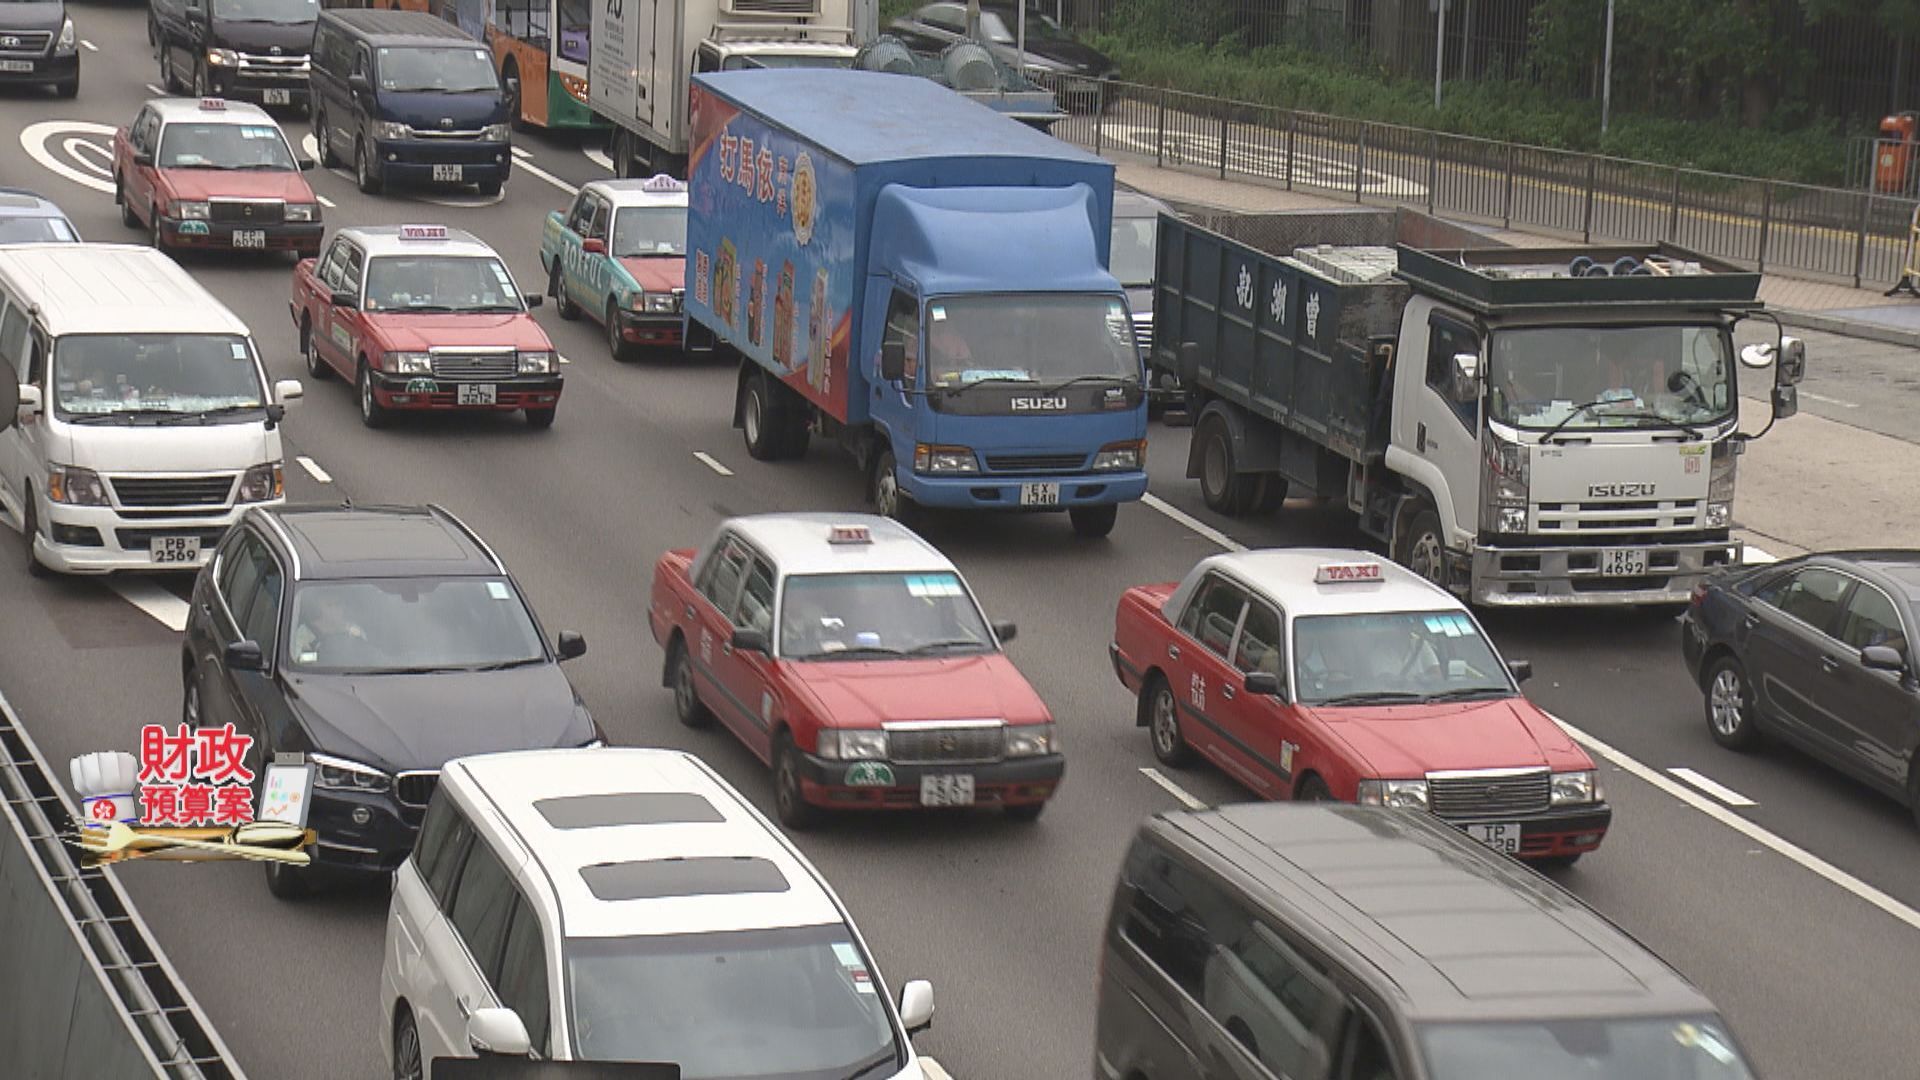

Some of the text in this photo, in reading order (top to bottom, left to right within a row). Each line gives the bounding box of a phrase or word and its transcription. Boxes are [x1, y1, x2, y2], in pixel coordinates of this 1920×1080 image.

[1011, 397, 1067, 410] ISUZU
[1588, 482, 1656, 498] ISUZU
[166, 537, 186, 550] PB
[155, 549, 196, 562] 2569
[1614, 550, 1635, 563] RF
[1327, 564, 1379, 579] TAXI
[1605, 561, 1644, 575] 4692
